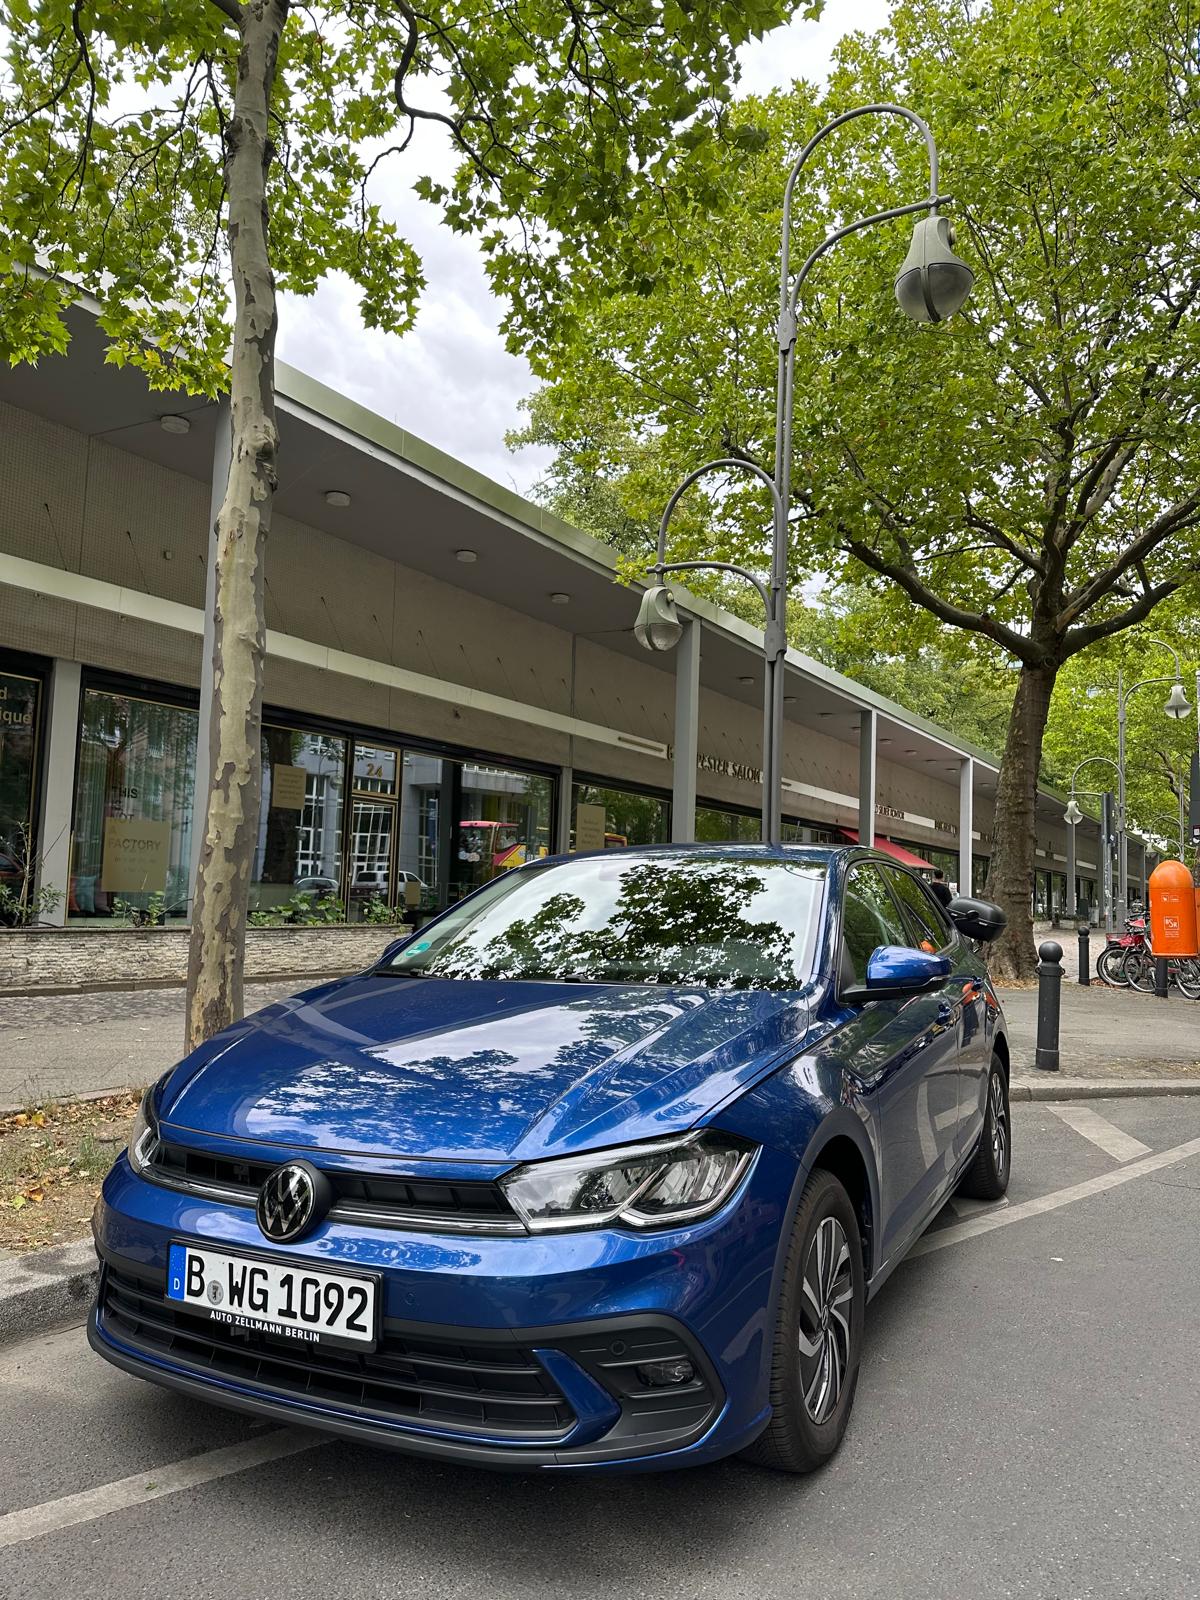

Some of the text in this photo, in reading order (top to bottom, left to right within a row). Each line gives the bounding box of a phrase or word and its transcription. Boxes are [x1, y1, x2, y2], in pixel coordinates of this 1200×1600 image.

[367, 763, 383, 778] 24
[111, 786, 138, 799] THIS
[108, 838, 161, 850] FACTORY
[173, 1254, 369, 1333] D B WG 1092
[209, 1310, 321, 1343] AUTO ZELLMANN BERLIN
